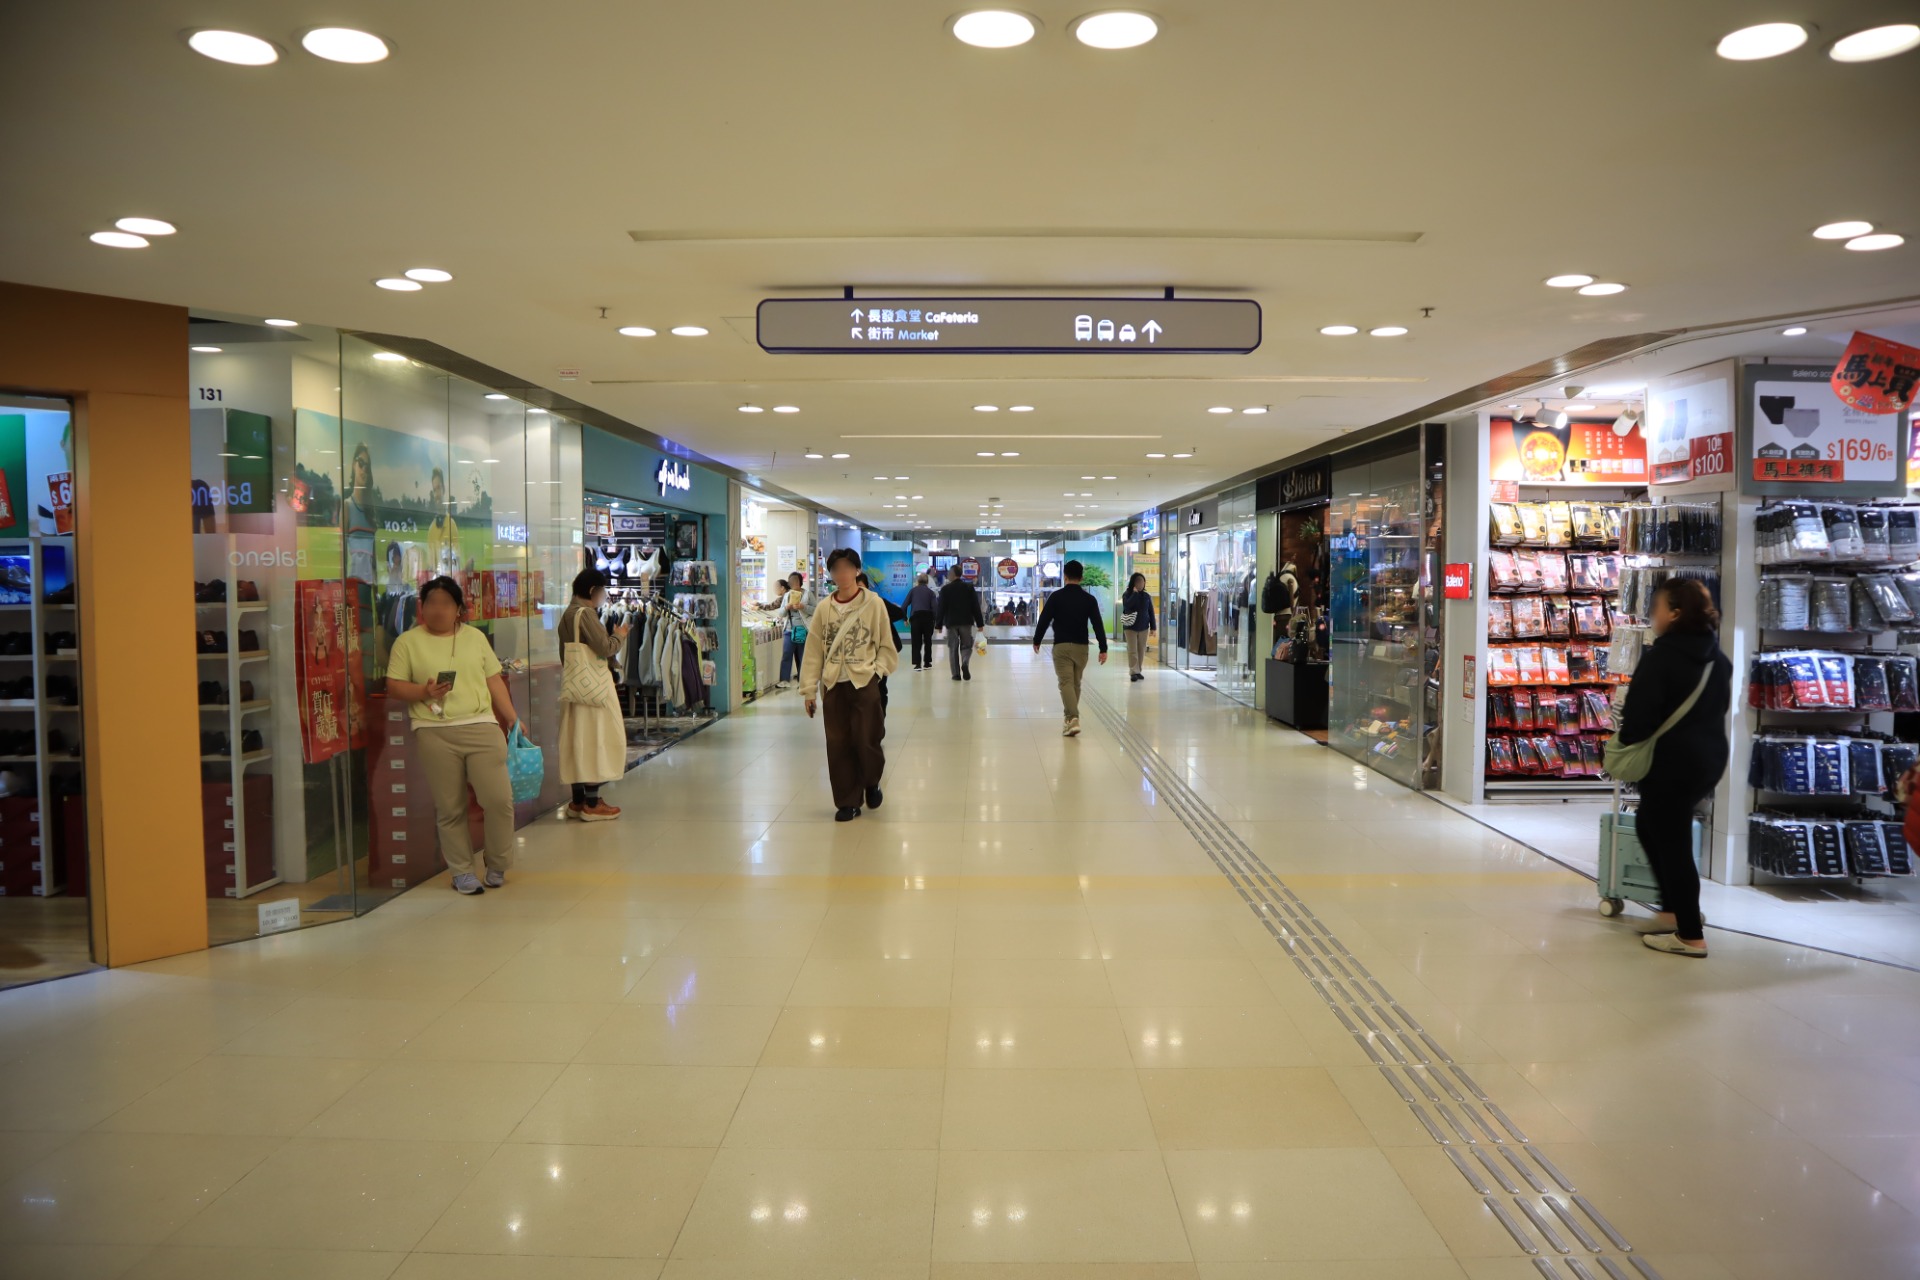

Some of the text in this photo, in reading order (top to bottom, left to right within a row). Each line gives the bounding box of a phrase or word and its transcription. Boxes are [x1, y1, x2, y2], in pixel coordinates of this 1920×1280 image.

[868, 308, 922, 323] 長發食堂
[867, 327, 940, 341] 街市 Market
[199, 387, 223, 402] 131
[1695, 452, 1724, 474] $100
[1445, 573, 1464, 588] Baleno
